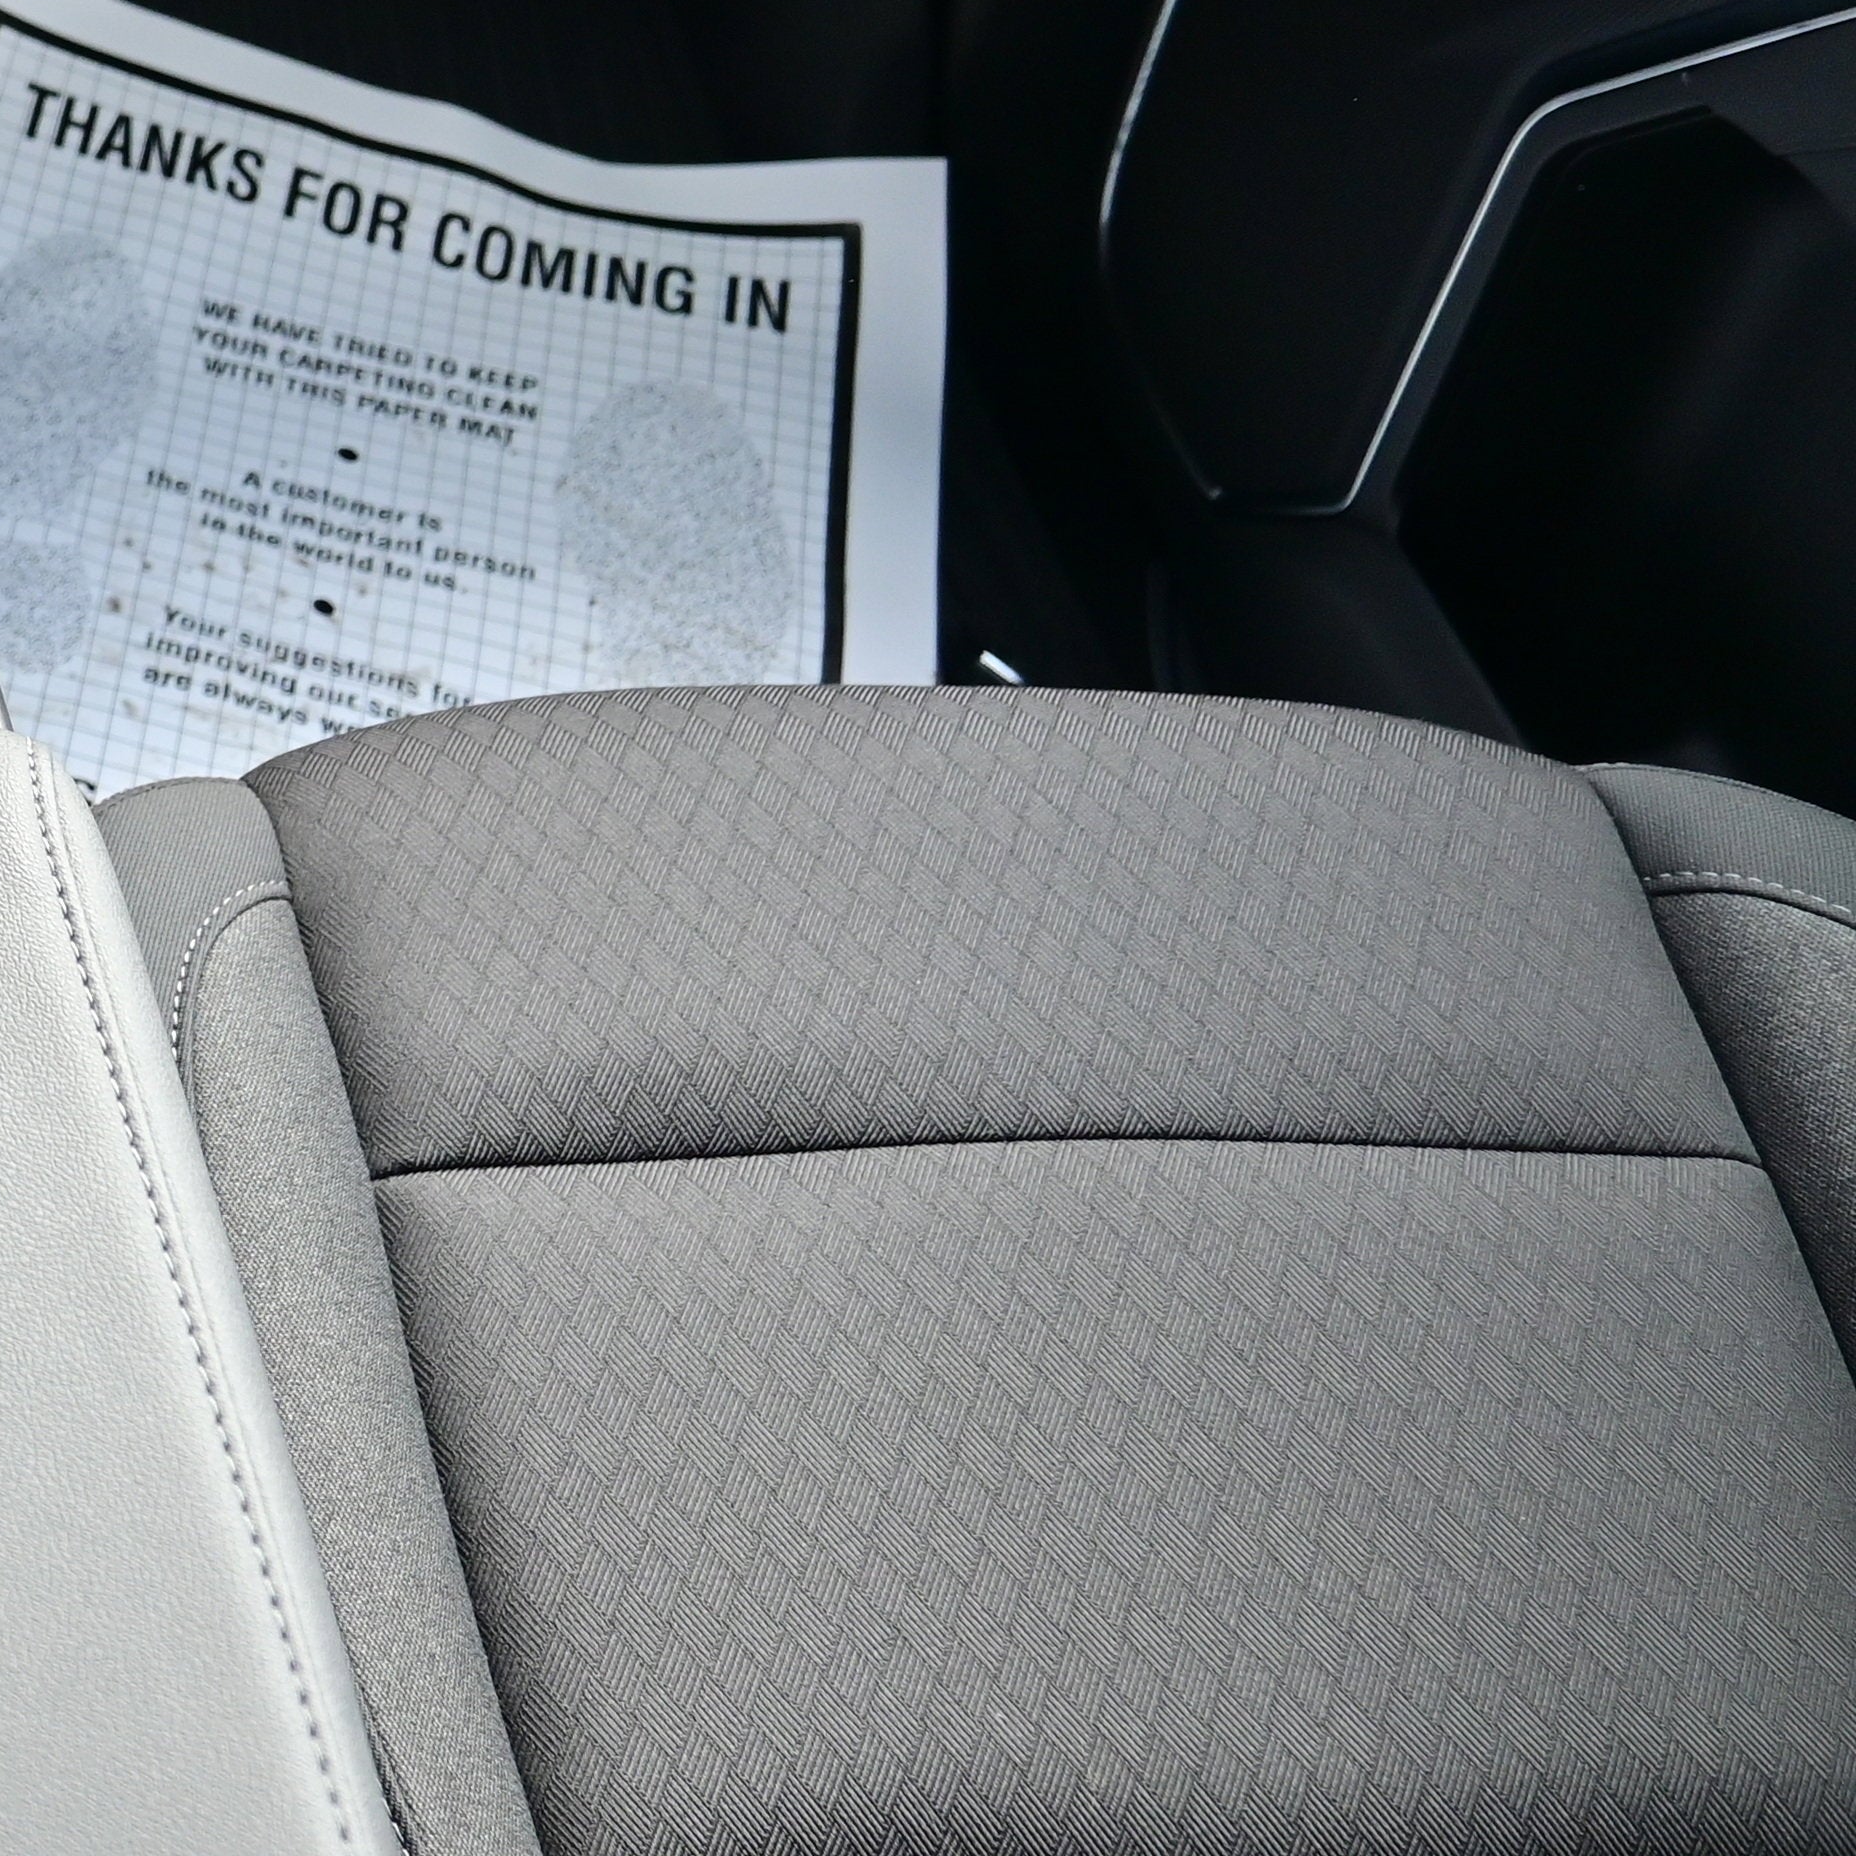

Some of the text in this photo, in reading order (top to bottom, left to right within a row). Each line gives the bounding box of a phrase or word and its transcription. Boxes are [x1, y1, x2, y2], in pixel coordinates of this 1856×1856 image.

[25, 82, 792, 335] THANKS FOR COMING IN
[192, 324, 538, 422] YOUR CARPETING CLEAN
[203, 298, 538, 392] WE HAVE TRIED TO KEEP
[203, 356, 275, 387] WITH
[286, 376, 348, 408] THIS
[357, 392, 448, 431] PAPER
[146, 469, 537, 582] the most important person
[243, 471, 444, 532] A customer is
[200, 512, 224, 531] in
[237, 520, 281, 547] the
[293, 540, 374, 574] world
[383, 559, 413, 581] to
[143, 666, 193, 692] are
[202, 681, 310, 726] always
[145, 631, 299, 694] improving
[308, 682, 361, 711] our
[162, 604, 228, 640] Your
[238, 632, 420, 699] suggestions
[430, 682, 475, 709] for
